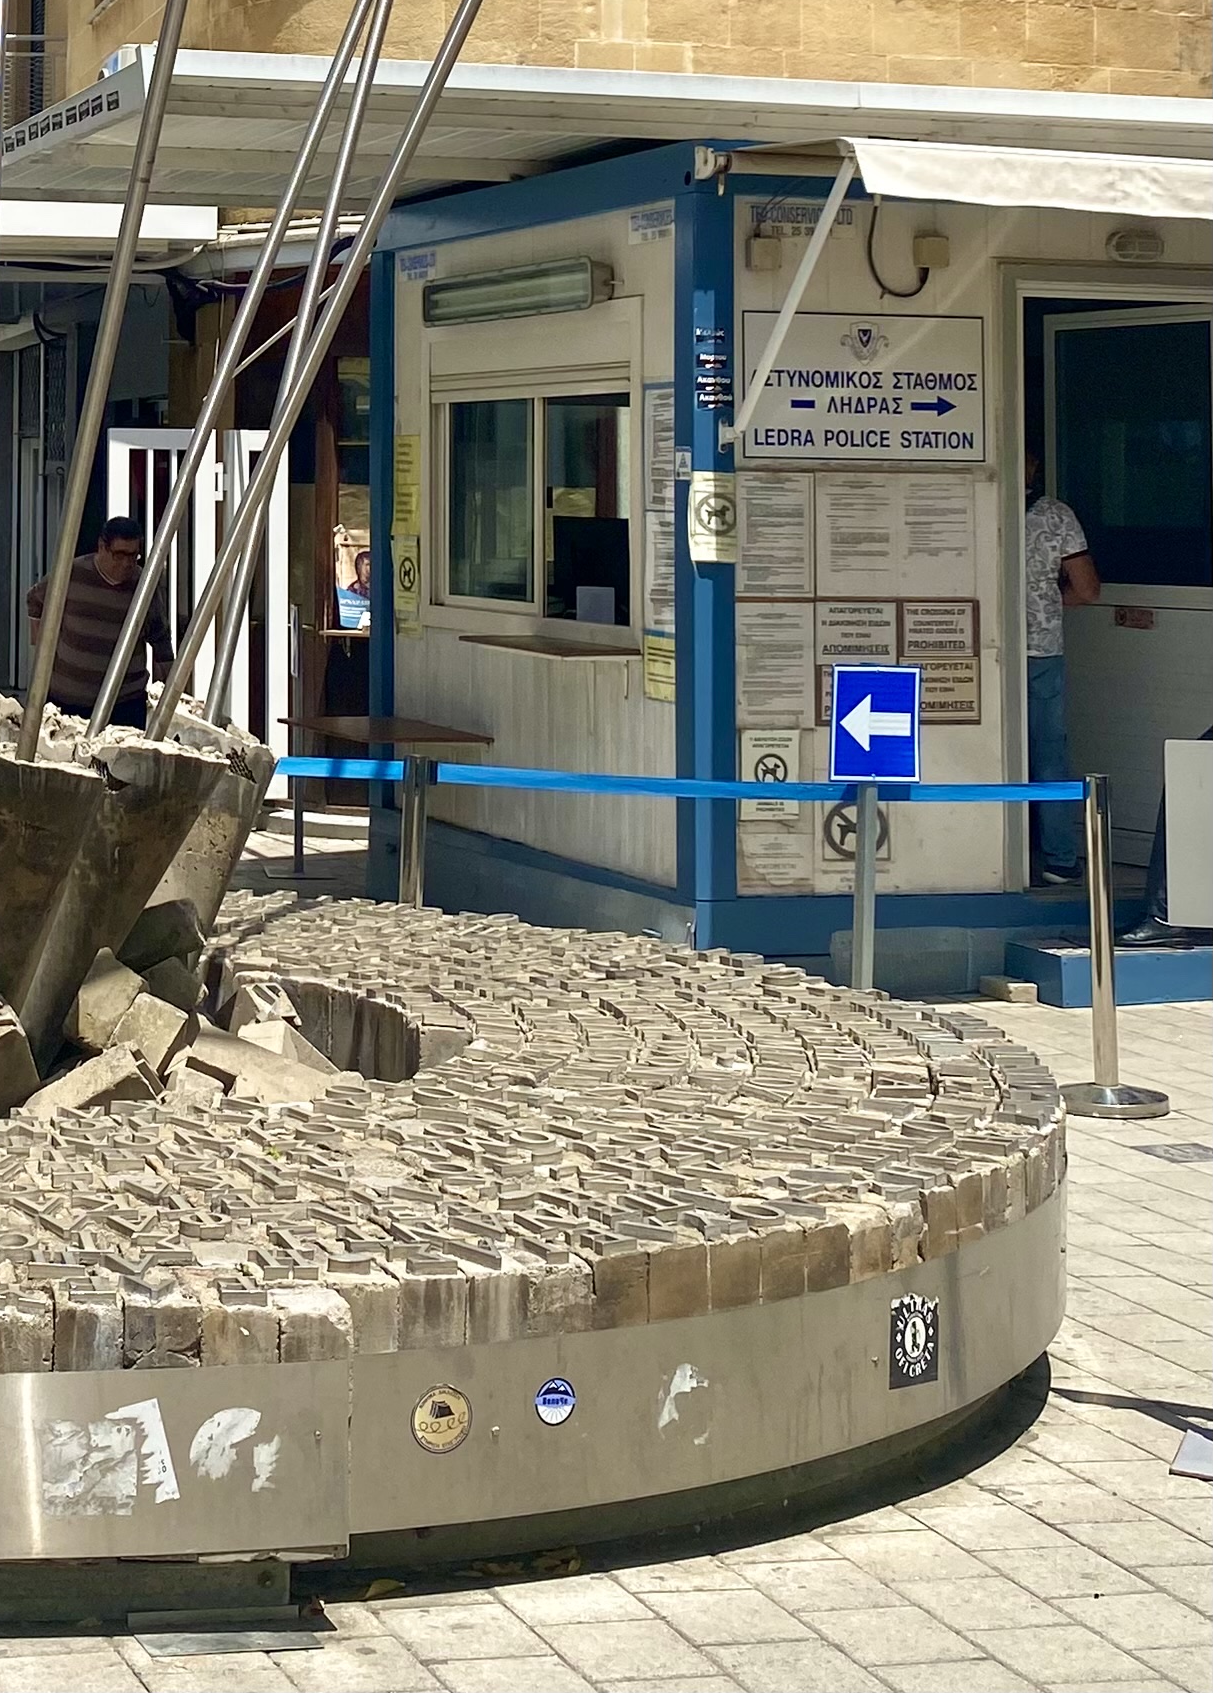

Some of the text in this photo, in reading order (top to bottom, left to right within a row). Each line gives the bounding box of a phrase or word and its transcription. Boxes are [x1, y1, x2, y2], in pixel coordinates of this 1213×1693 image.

[893, 372, 978, 391] ΣΤΑΘΜΟΣ
[827, 396, 903, 415] ΛΗΔΡΑΣ
[754, 428, 974, 449] LEDRA POLICE STATION
